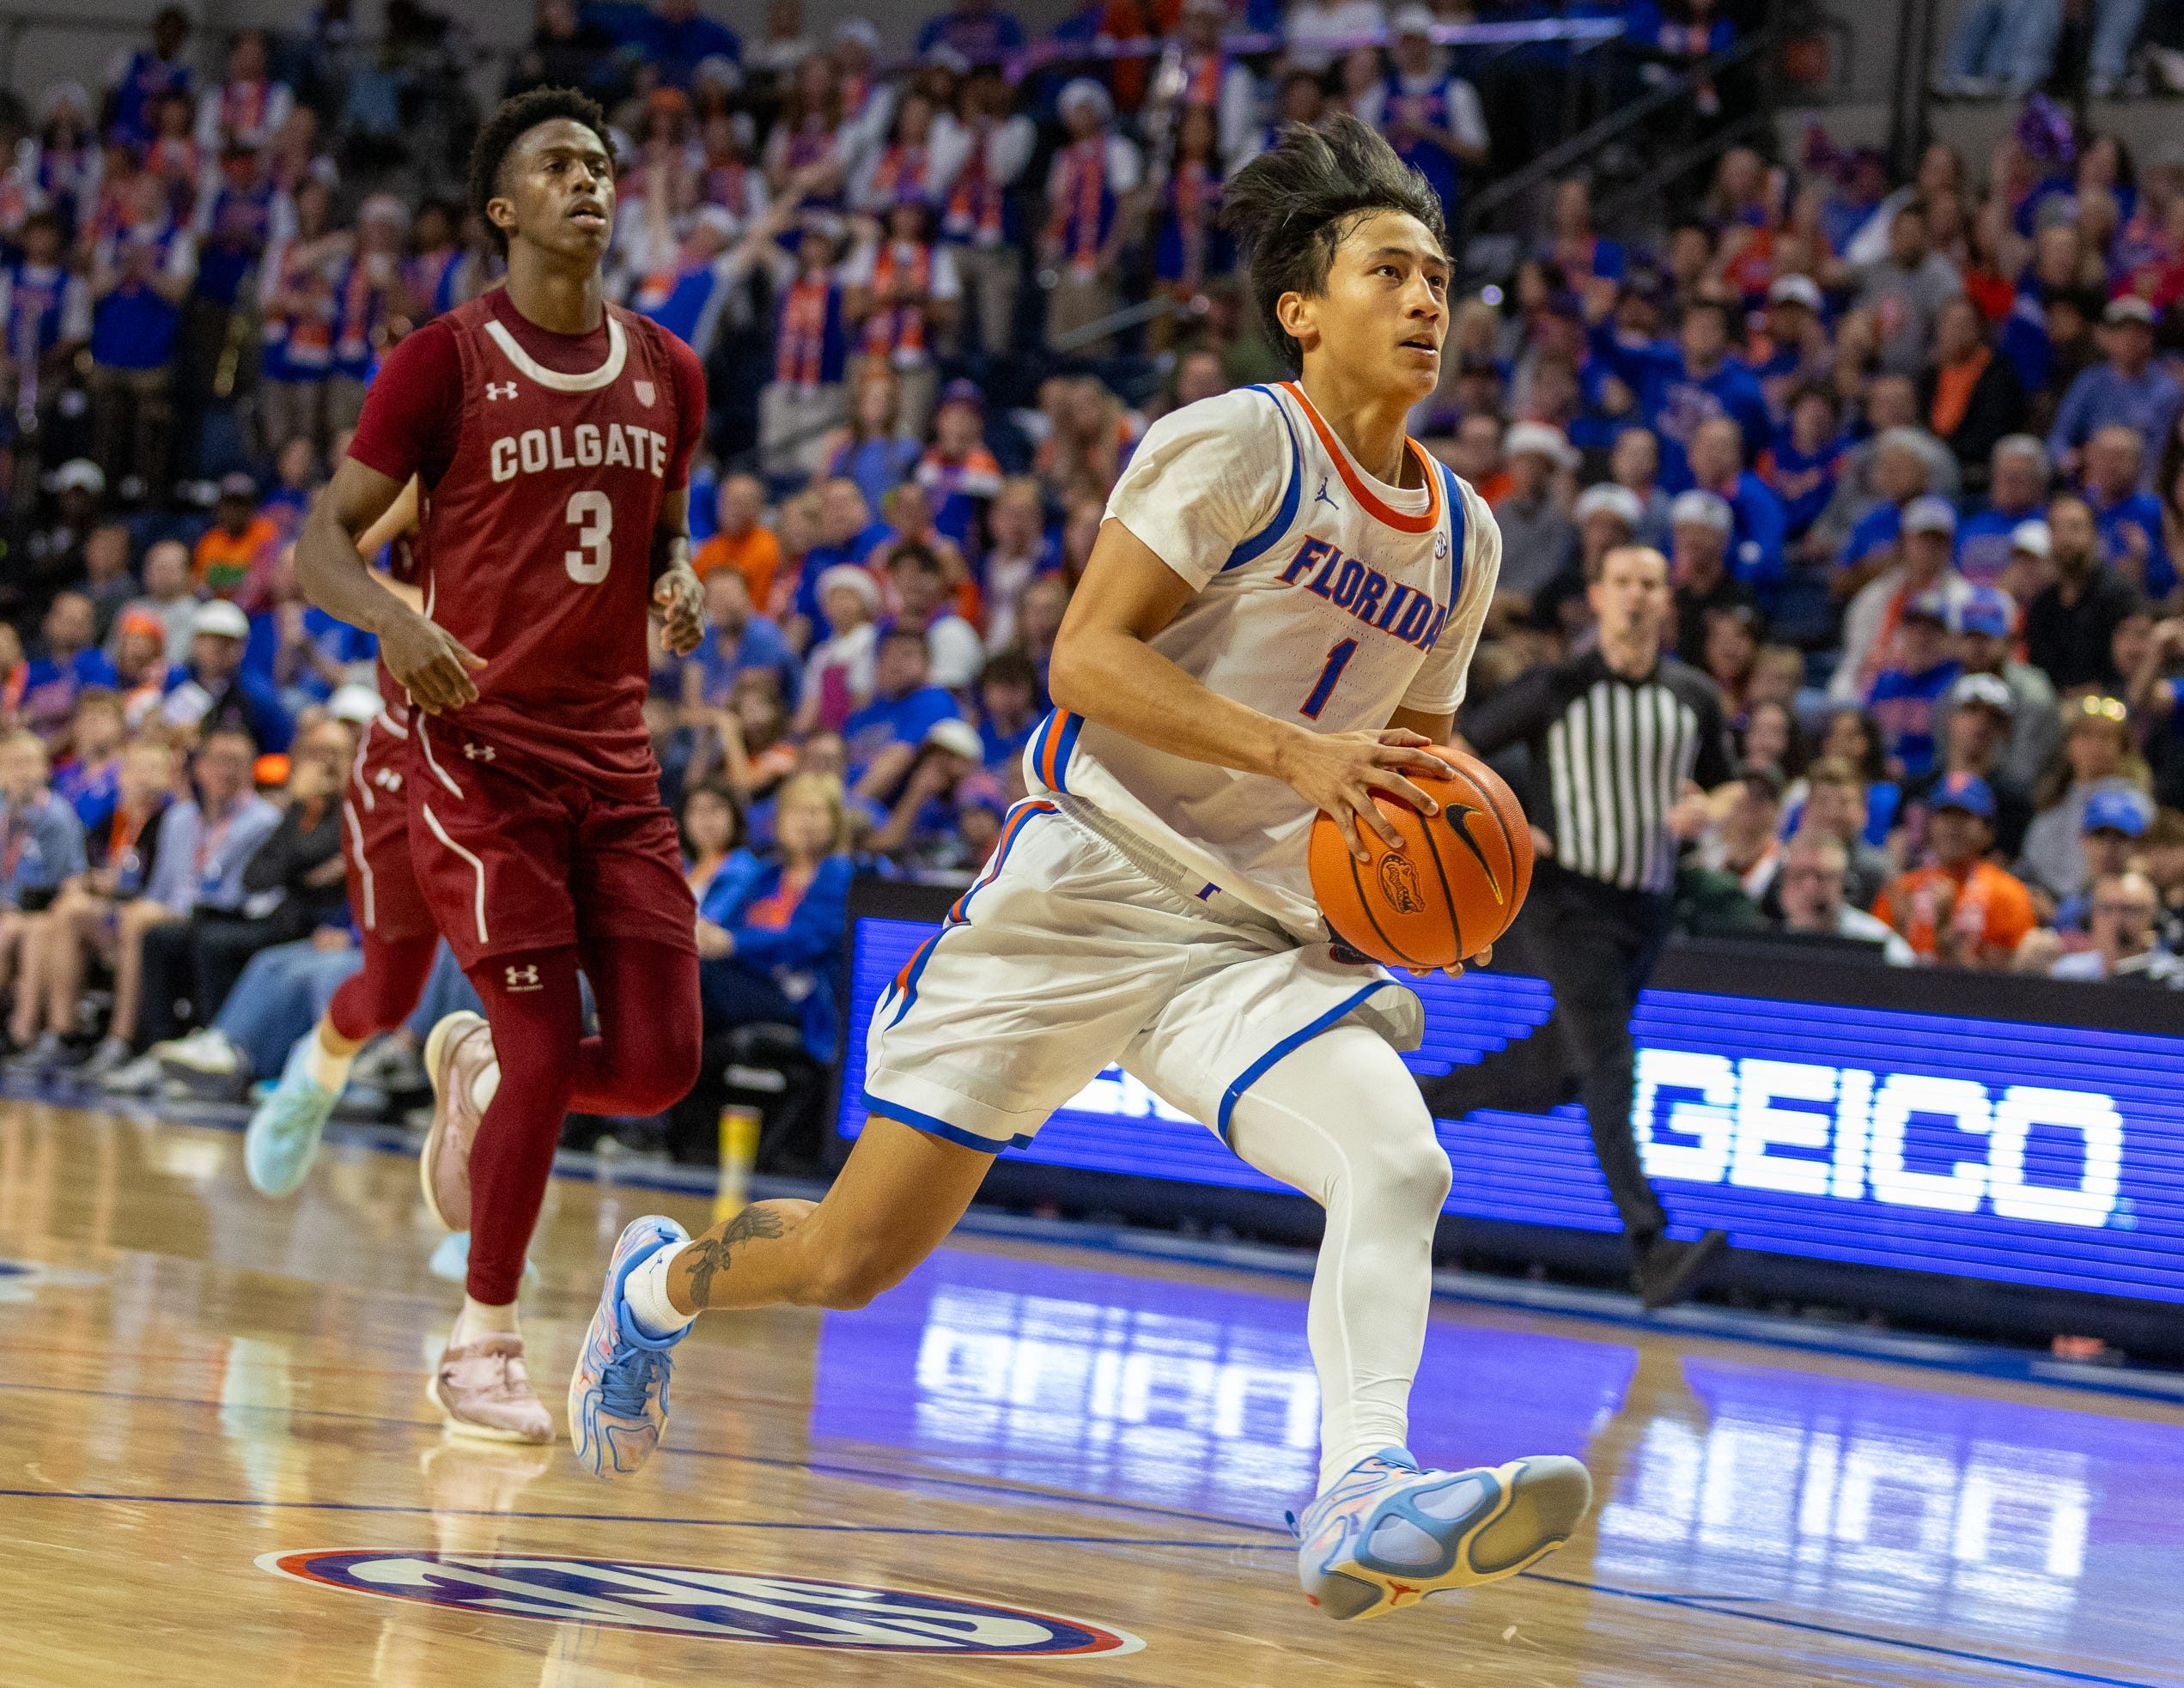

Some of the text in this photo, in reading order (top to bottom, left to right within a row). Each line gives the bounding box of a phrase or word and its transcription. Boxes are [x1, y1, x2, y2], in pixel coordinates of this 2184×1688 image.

[490, 422, 667, 483] COLGATE
[564, 489, 613, 585] 3
[1274, 534, 1448, 655] FLORIDA
[1299, 636, 1360, 721] 1
[1633, 1047, 2125, 1228] GEICO
